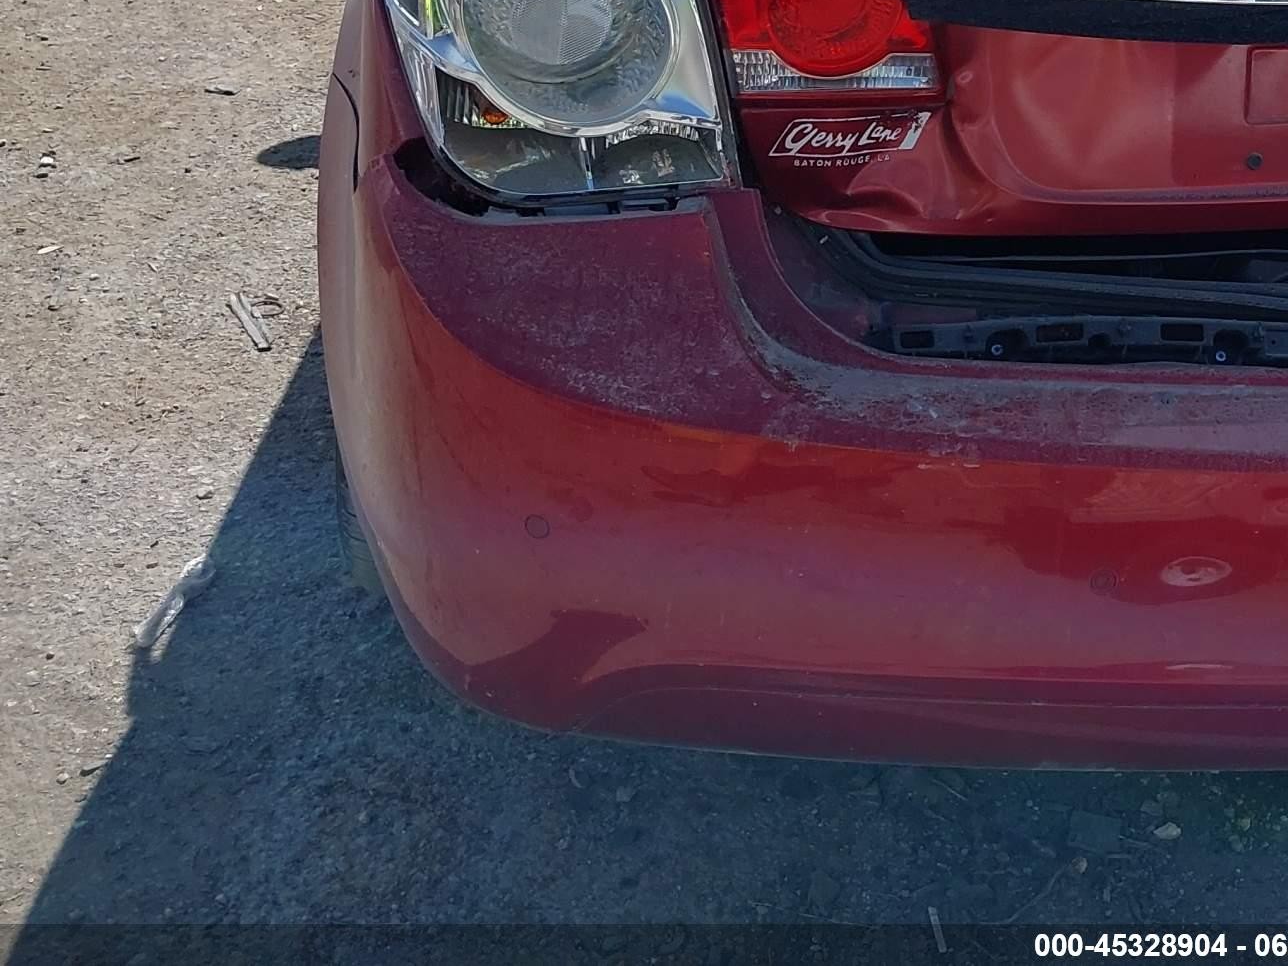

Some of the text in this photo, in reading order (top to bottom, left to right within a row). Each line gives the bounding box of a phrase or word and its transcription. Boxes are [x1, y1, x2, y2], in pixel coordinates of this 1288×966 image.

[784, 121, 903, 156] Gerry Lane
[793, 159, 832, 167] BATON
